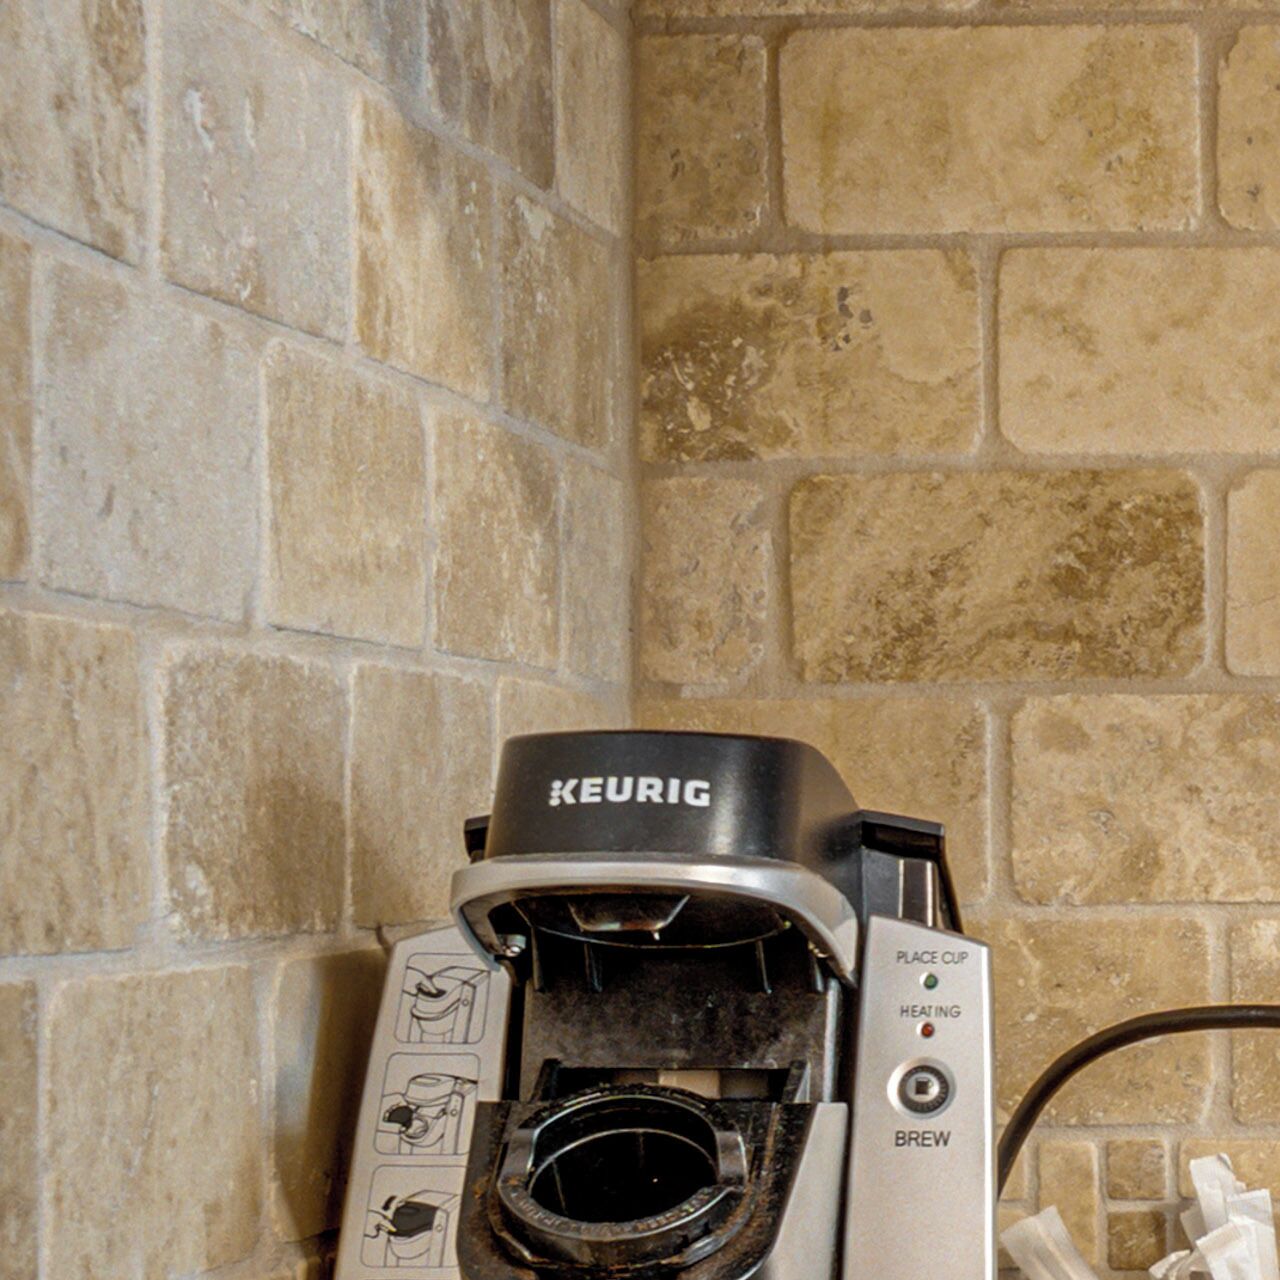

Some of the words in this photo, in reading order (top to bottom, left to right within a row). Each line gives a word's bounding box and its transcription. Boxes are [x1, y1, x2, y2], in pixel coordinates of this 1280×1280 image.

[549, 776, 711, 807] KEURIG
[896, 951, 939, 965] PLACE
[941, 951, 969, 965] CUP
[900, 1004, 962, 1019] HEATING
[894, 1130, 951, 1147] BREW
